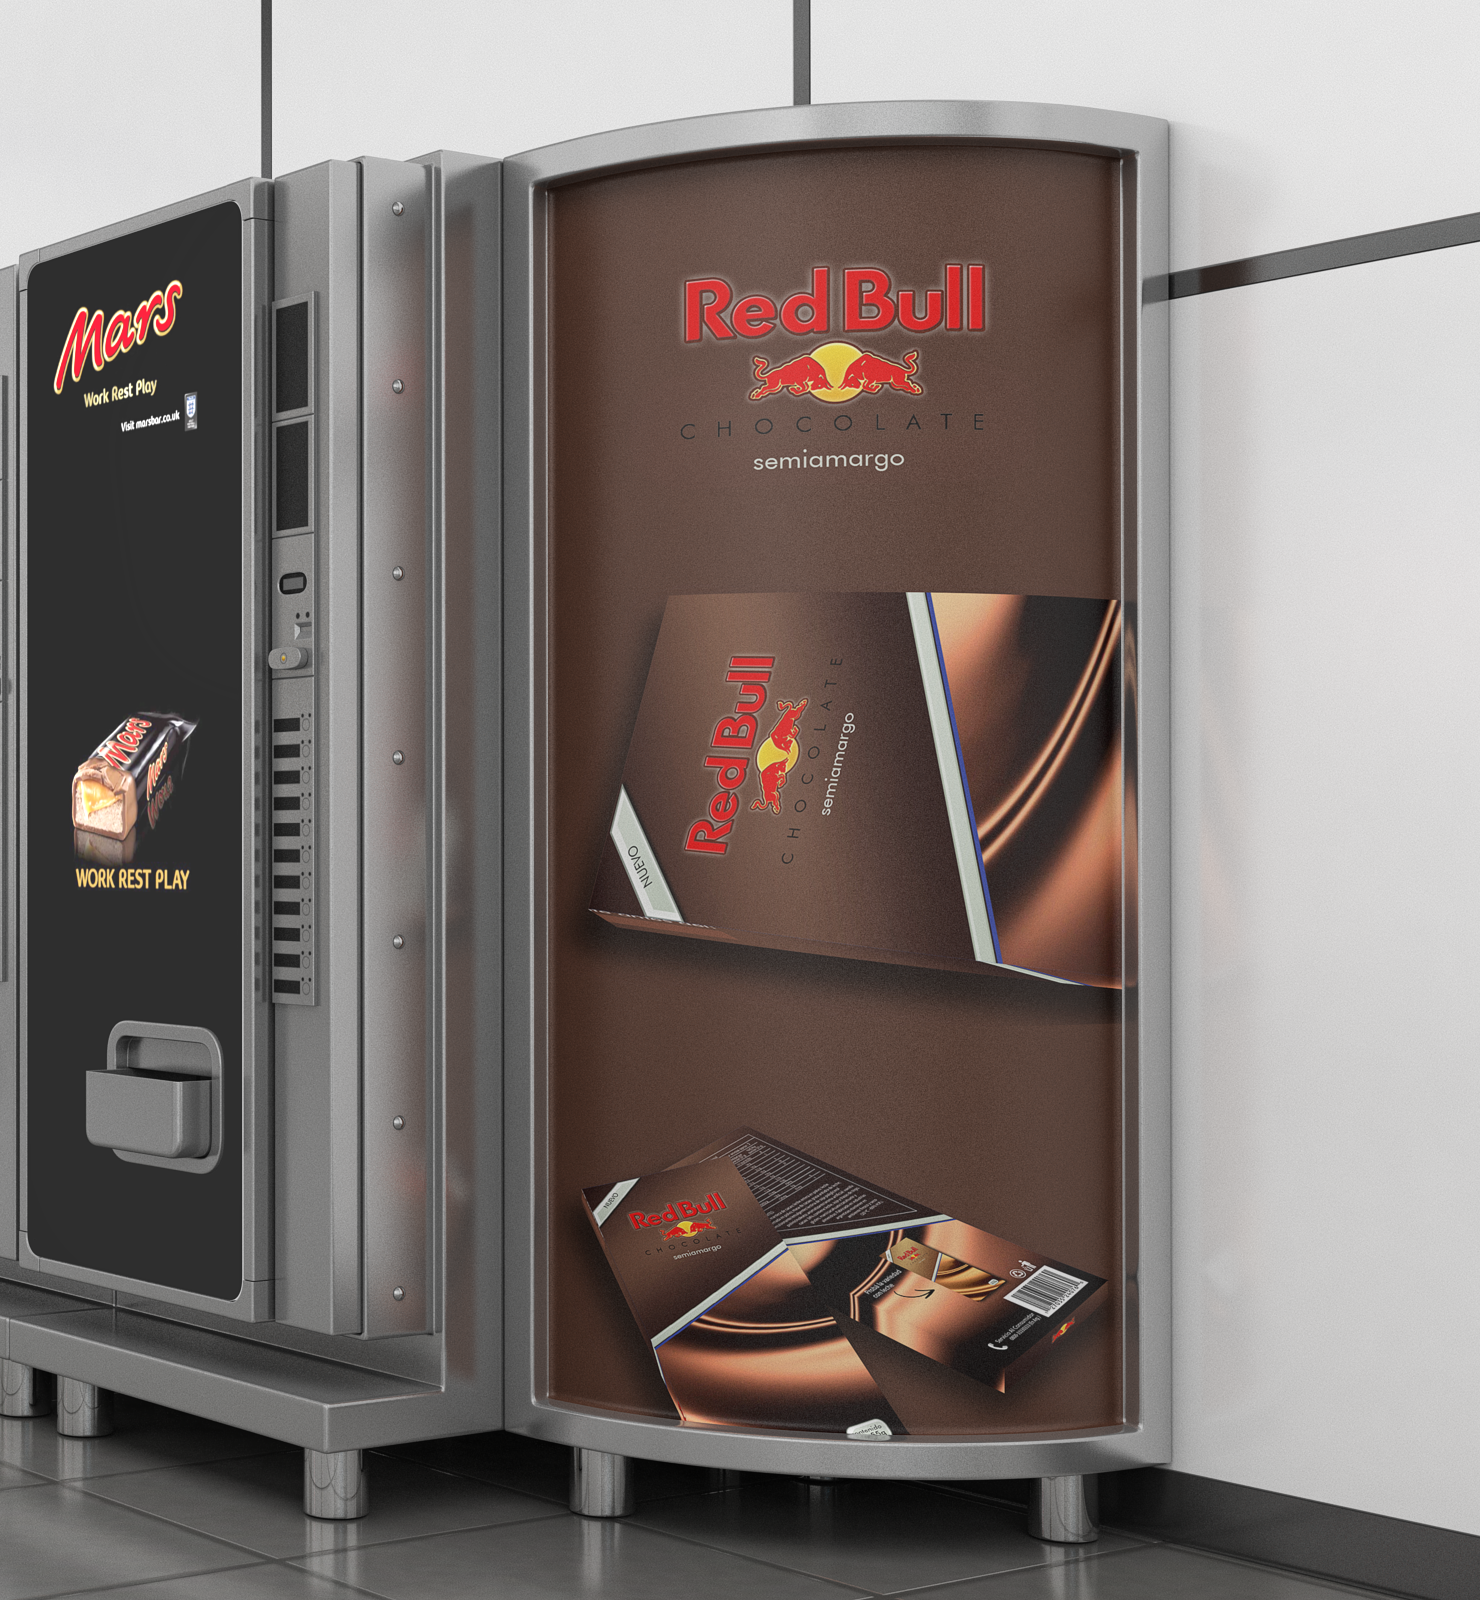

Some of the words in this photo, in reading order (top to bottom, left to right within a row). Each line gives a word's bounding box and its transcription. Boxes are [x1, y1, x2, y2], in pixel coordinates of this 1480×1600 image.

[685, 267, 830, 343] Red
[843, 264, 985, 333] Bull
[54, 279, 183, 395] Mars
[83, 388, 110, 408] Work
[111, 382, 134, 402] Rest
[135, 378, 158, 397] Play
[120, 420, 135, 432] Visit
[135, 410, 180, 430] marsbar.co.uk
[680, 413, 985, 440] CHOCOLATE
[753, 448, 905, 472] semiamargo
[710, 656, 775, 749] Bull
[97, 717, 152, 771] Mars
[781, 657, 843, 865] CHOCOLATE
[821, 712, 856, 816] semiamargo
[146, 740, 169, 801] Mars
[685, 756, 750, 855] Red
[75, 868, 116, 889] WORK
[118, 868, 152, 890] REST
[155, 869, 190, 890] PLAY
[627, 845, 653, 889] NUEVO
[603, 1192, 619, 1209] NUEVO
[628, 1203, 679, 1230] Red
[675, 1191, 728, 1219] Bull
[644, 1227, 742, 1256] CHOCOLATE
[673, 1243, 722, 1260] semiamargo
